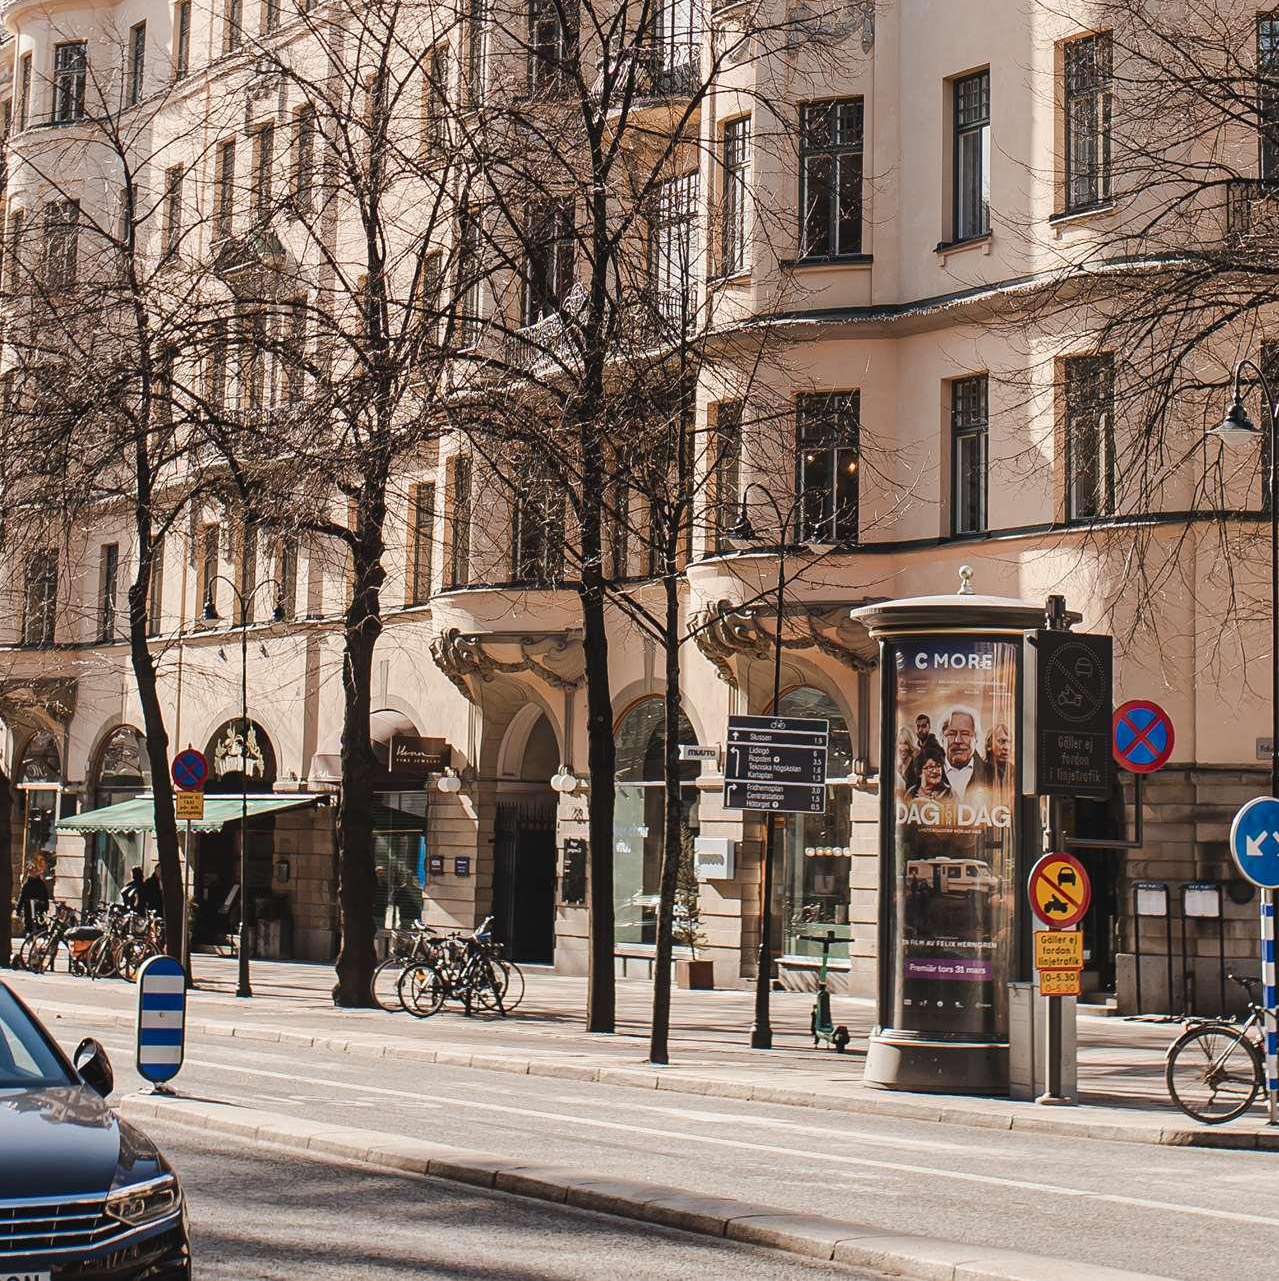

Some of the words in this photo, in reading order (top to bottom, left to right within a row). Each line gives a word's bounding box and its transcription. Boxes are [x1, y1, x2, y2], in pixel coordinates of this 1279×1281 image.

[914, 652, 928, 670] C
[933, 652, 993, 670] MORE
[896, 802, 940, 826] DAG
[957, 803, 1012, 828] DAG
[1069, 934, 1078, 945] ej
